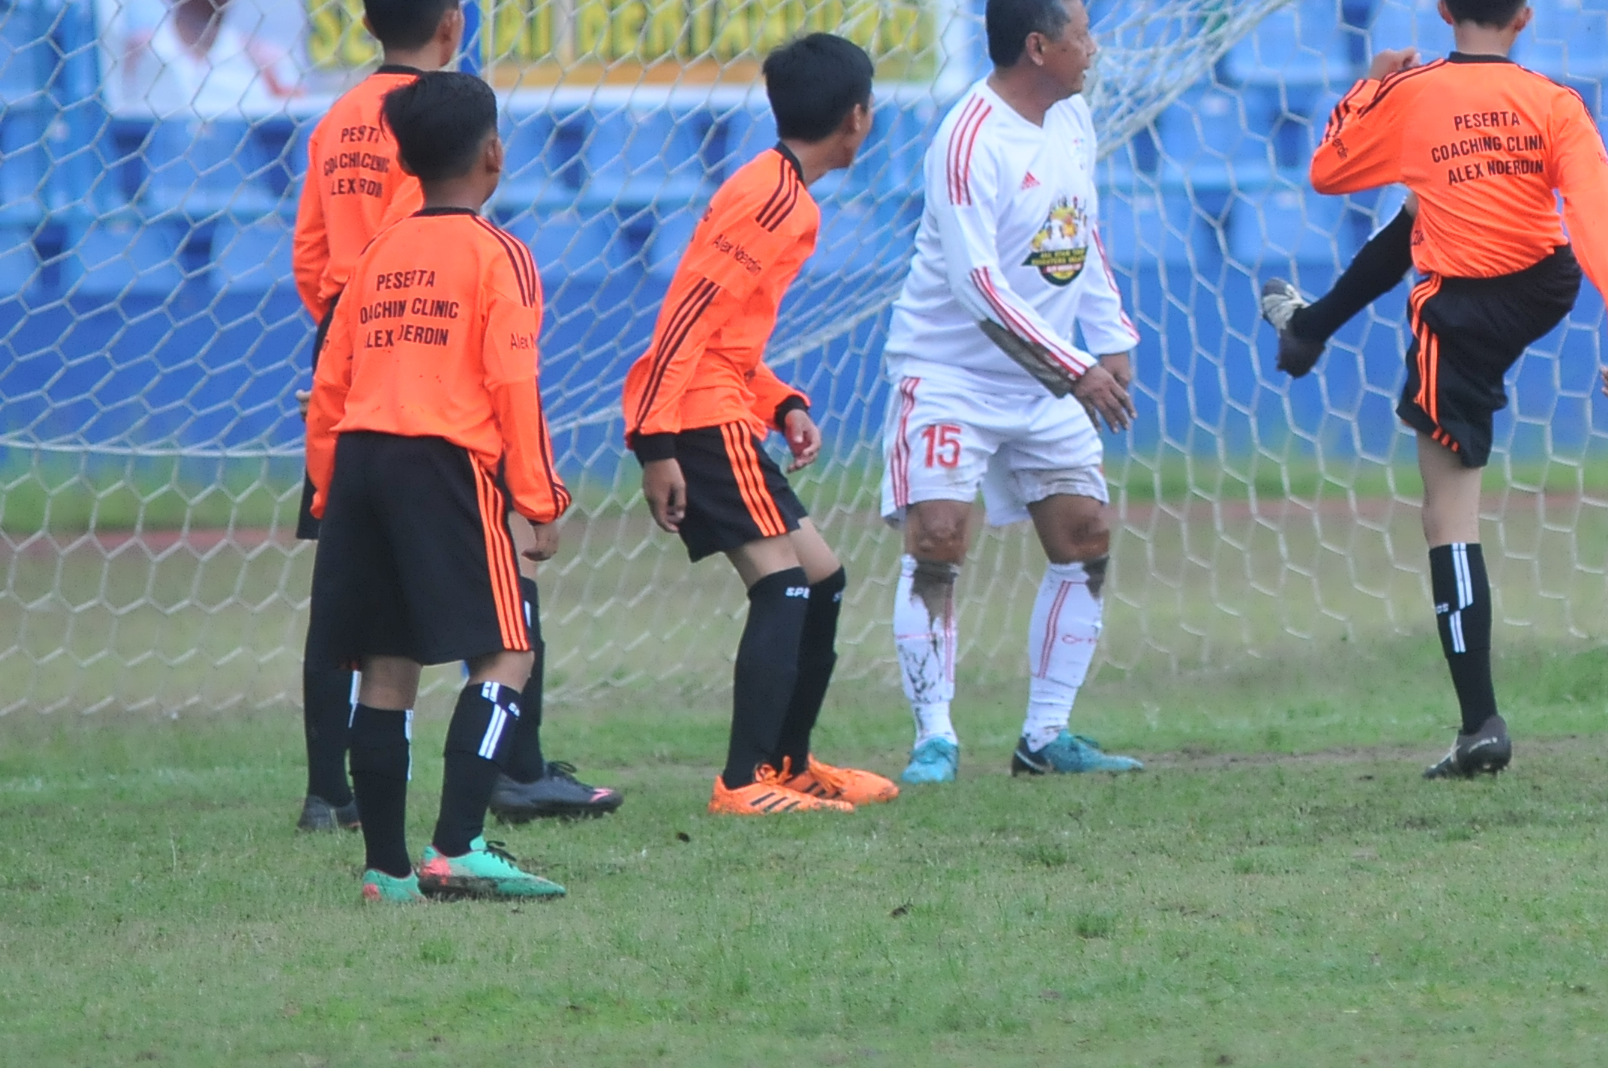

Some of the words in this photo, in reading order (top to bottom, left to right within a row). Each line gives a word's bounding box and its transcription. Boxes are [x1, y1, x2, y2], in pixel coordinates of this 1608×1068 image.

[1453, 111, 1520, 131] PESERTA
[1431, 135, 1502, 163] COACHING
[1447, 162, 1484, 186] ALEX
[1486, 159, 1544, 176] NOERDIN
[411, 297, 459, 319] CLINIC
[921, 424, 962, 469] 15
